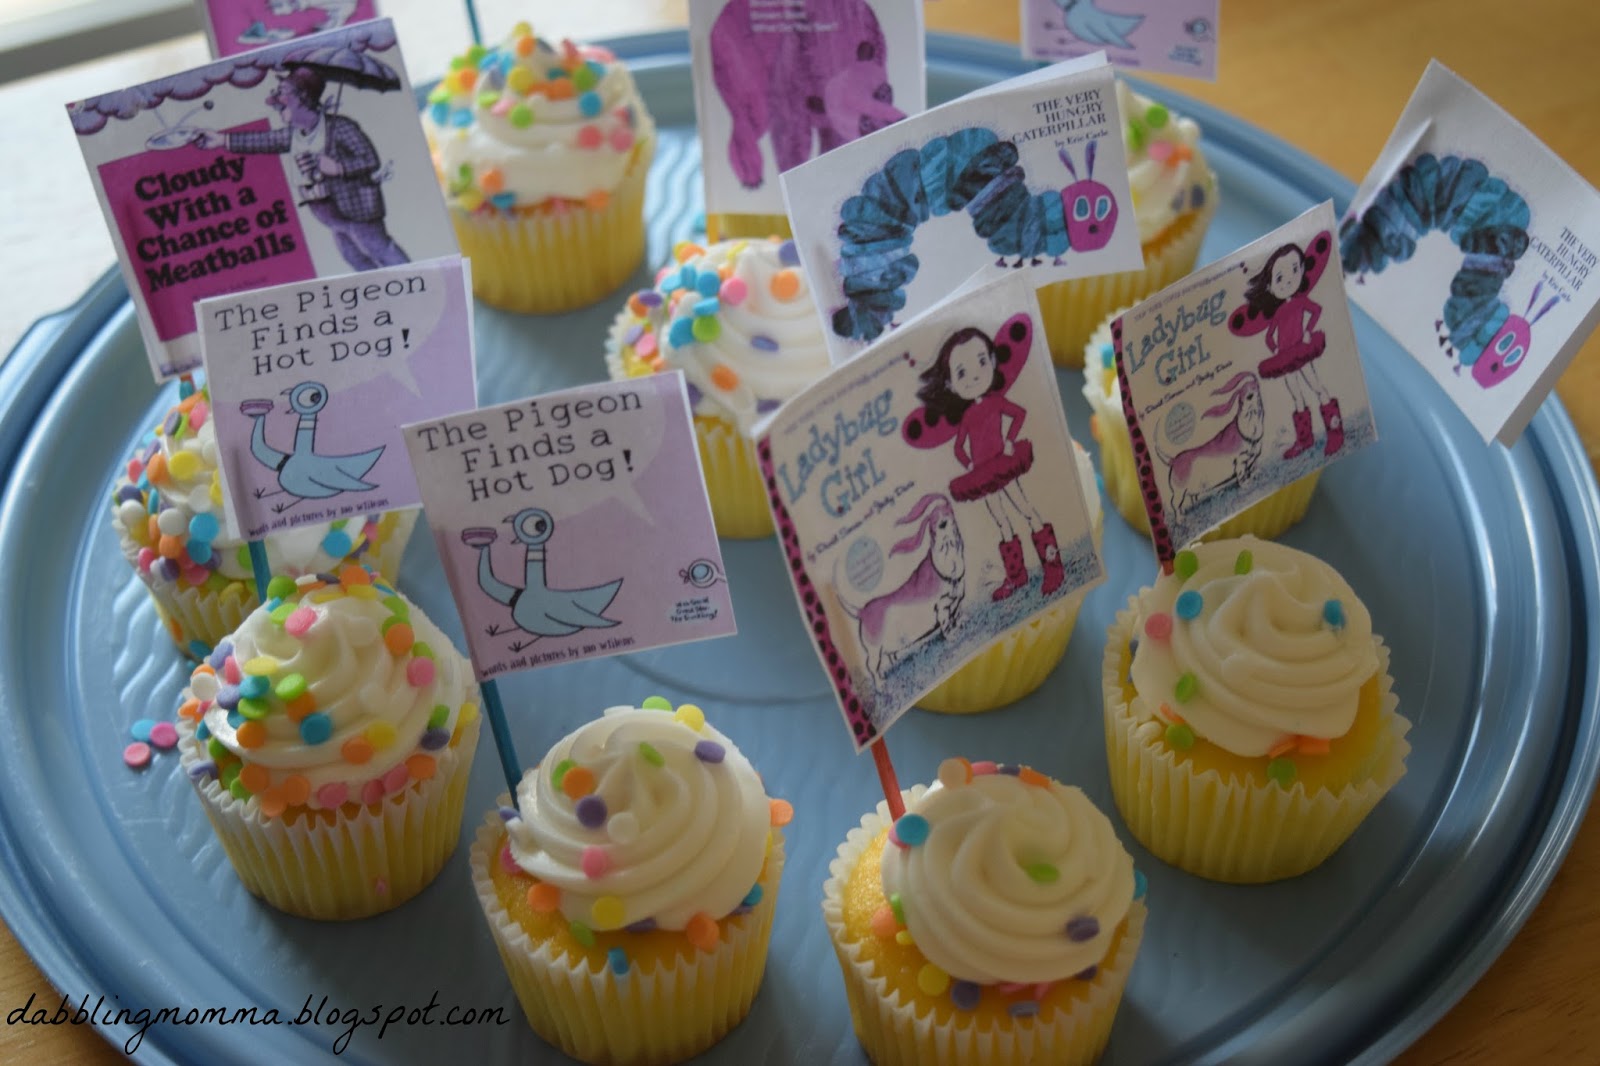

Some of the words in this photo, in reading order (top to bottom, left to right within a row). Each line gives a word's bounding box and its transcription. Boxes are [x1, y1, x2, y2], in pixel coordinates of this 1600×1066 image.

[1032, 98, 1062, 114] THE
[1065, 88, 1102, 105] VERY
[1045, 101, 1103, 123] HUNGRY
[1012, 113, 1106, 144] CATERPILLAR
[135, 156, 245, 201] Cloudy
[136, 216, 250, 262] Chance
[256, 200, 289, 228] of
[145, 190, 232, 231] With
[238, 187, 257, 206] a
[145, 233, 296, 292] Meatballs
[1530, 236, 1583, 291] CATERPILLAR
[1556, 242, 1592, 279] HUNGRY
[1560, 225, 1579, 247] THE
[1578, 243, 1599, 268] VERY
[214, 303, 279, 332] The
[296, 275, 427, 313] Pigeon
[251, 314, 359, 350] Finds
[373, 310, 393, 327] a
[252, 348, 314, 376] Hot
[330, 328, 410, 362] Dog!
[1125, 289, 1227, 375] Ladybug
[417, 420, 488, 453] The
[504, 391, 642, 433] Pigeon
[461, 433, 576, 474] Finds
[590, 428, 612, 447] a
[778, 388, 899, 505] Ladybug
[467, 471, 534, 502] Hot
[548, 449, 634, 486] Dog!
[568, 647, 580, 658] by
